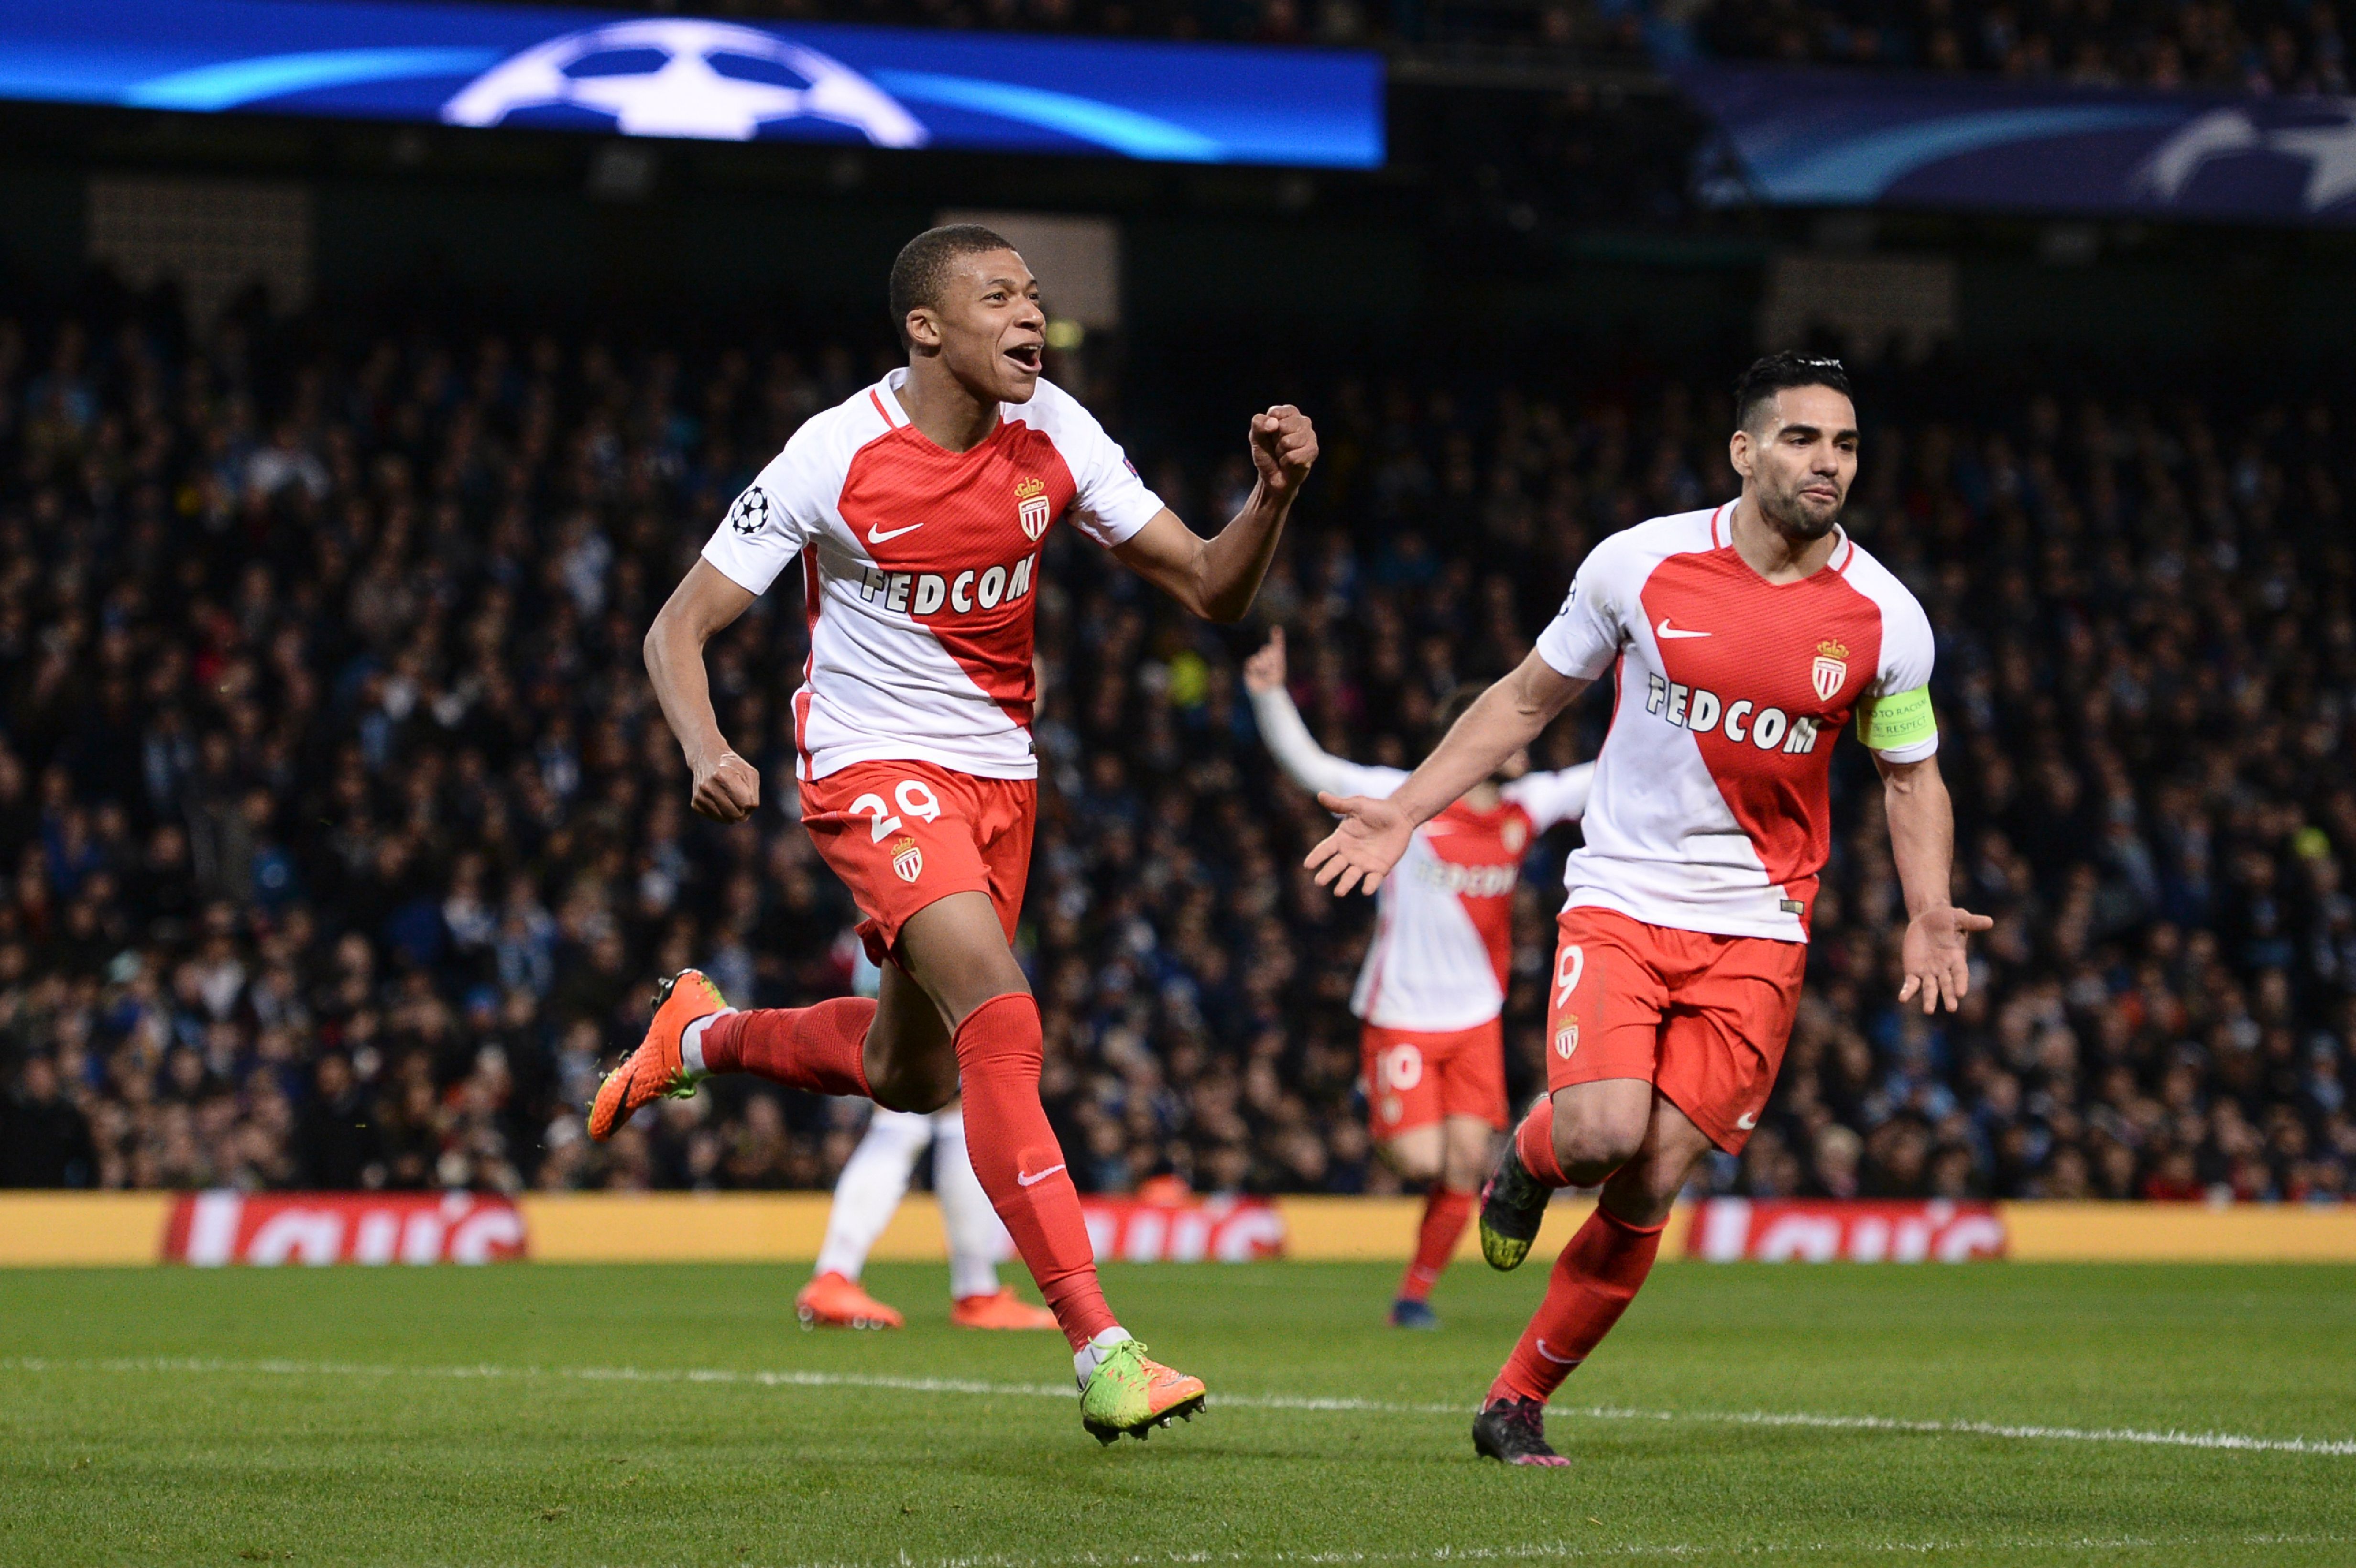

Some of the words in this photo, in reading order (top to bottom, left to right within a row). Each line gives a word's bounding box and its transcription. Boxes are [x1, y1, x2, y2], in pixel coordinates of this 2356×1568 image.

[860, 552, 1036, 615] FEDCOM
[1646, 671, 1822, 753] FEDCOM
[1879, 710, 1893, 718] TO
[1886, 715, 1926, 734] RESPECT
[848, 779, 941, 844] 29
[1557, 945, 1584, 1010] 9
